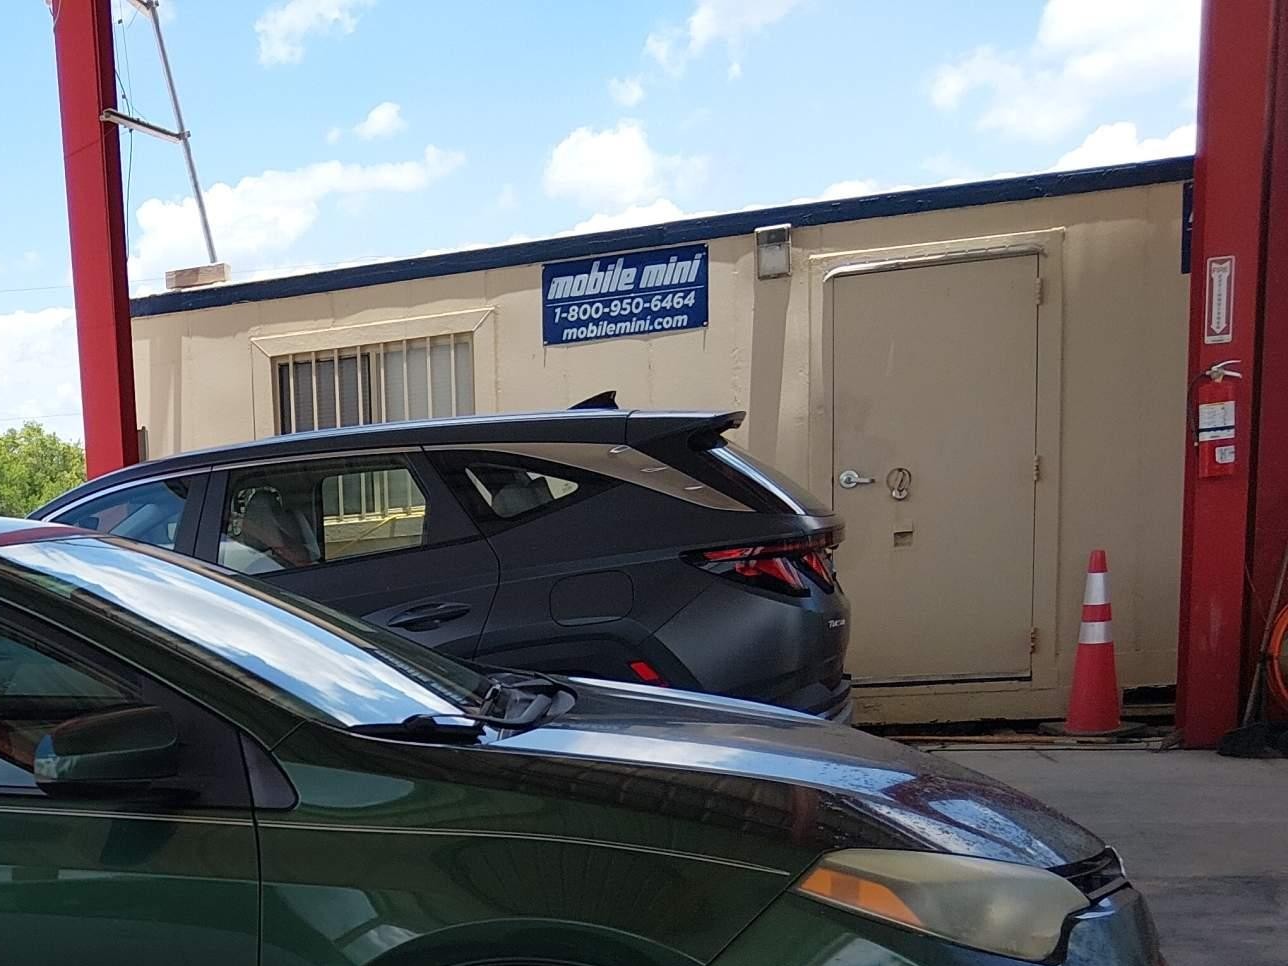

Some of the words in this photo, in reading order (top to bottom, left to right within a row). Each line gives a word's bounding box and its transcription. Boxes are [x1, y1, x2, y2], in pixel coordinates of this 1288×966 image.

[547, 258, 637, 300] mobile
[639, 254, 703, 288] mini
[554, 290, 695, 323] 1-800-950-6464
[562, 313, 688, 341] mobilemini.com
